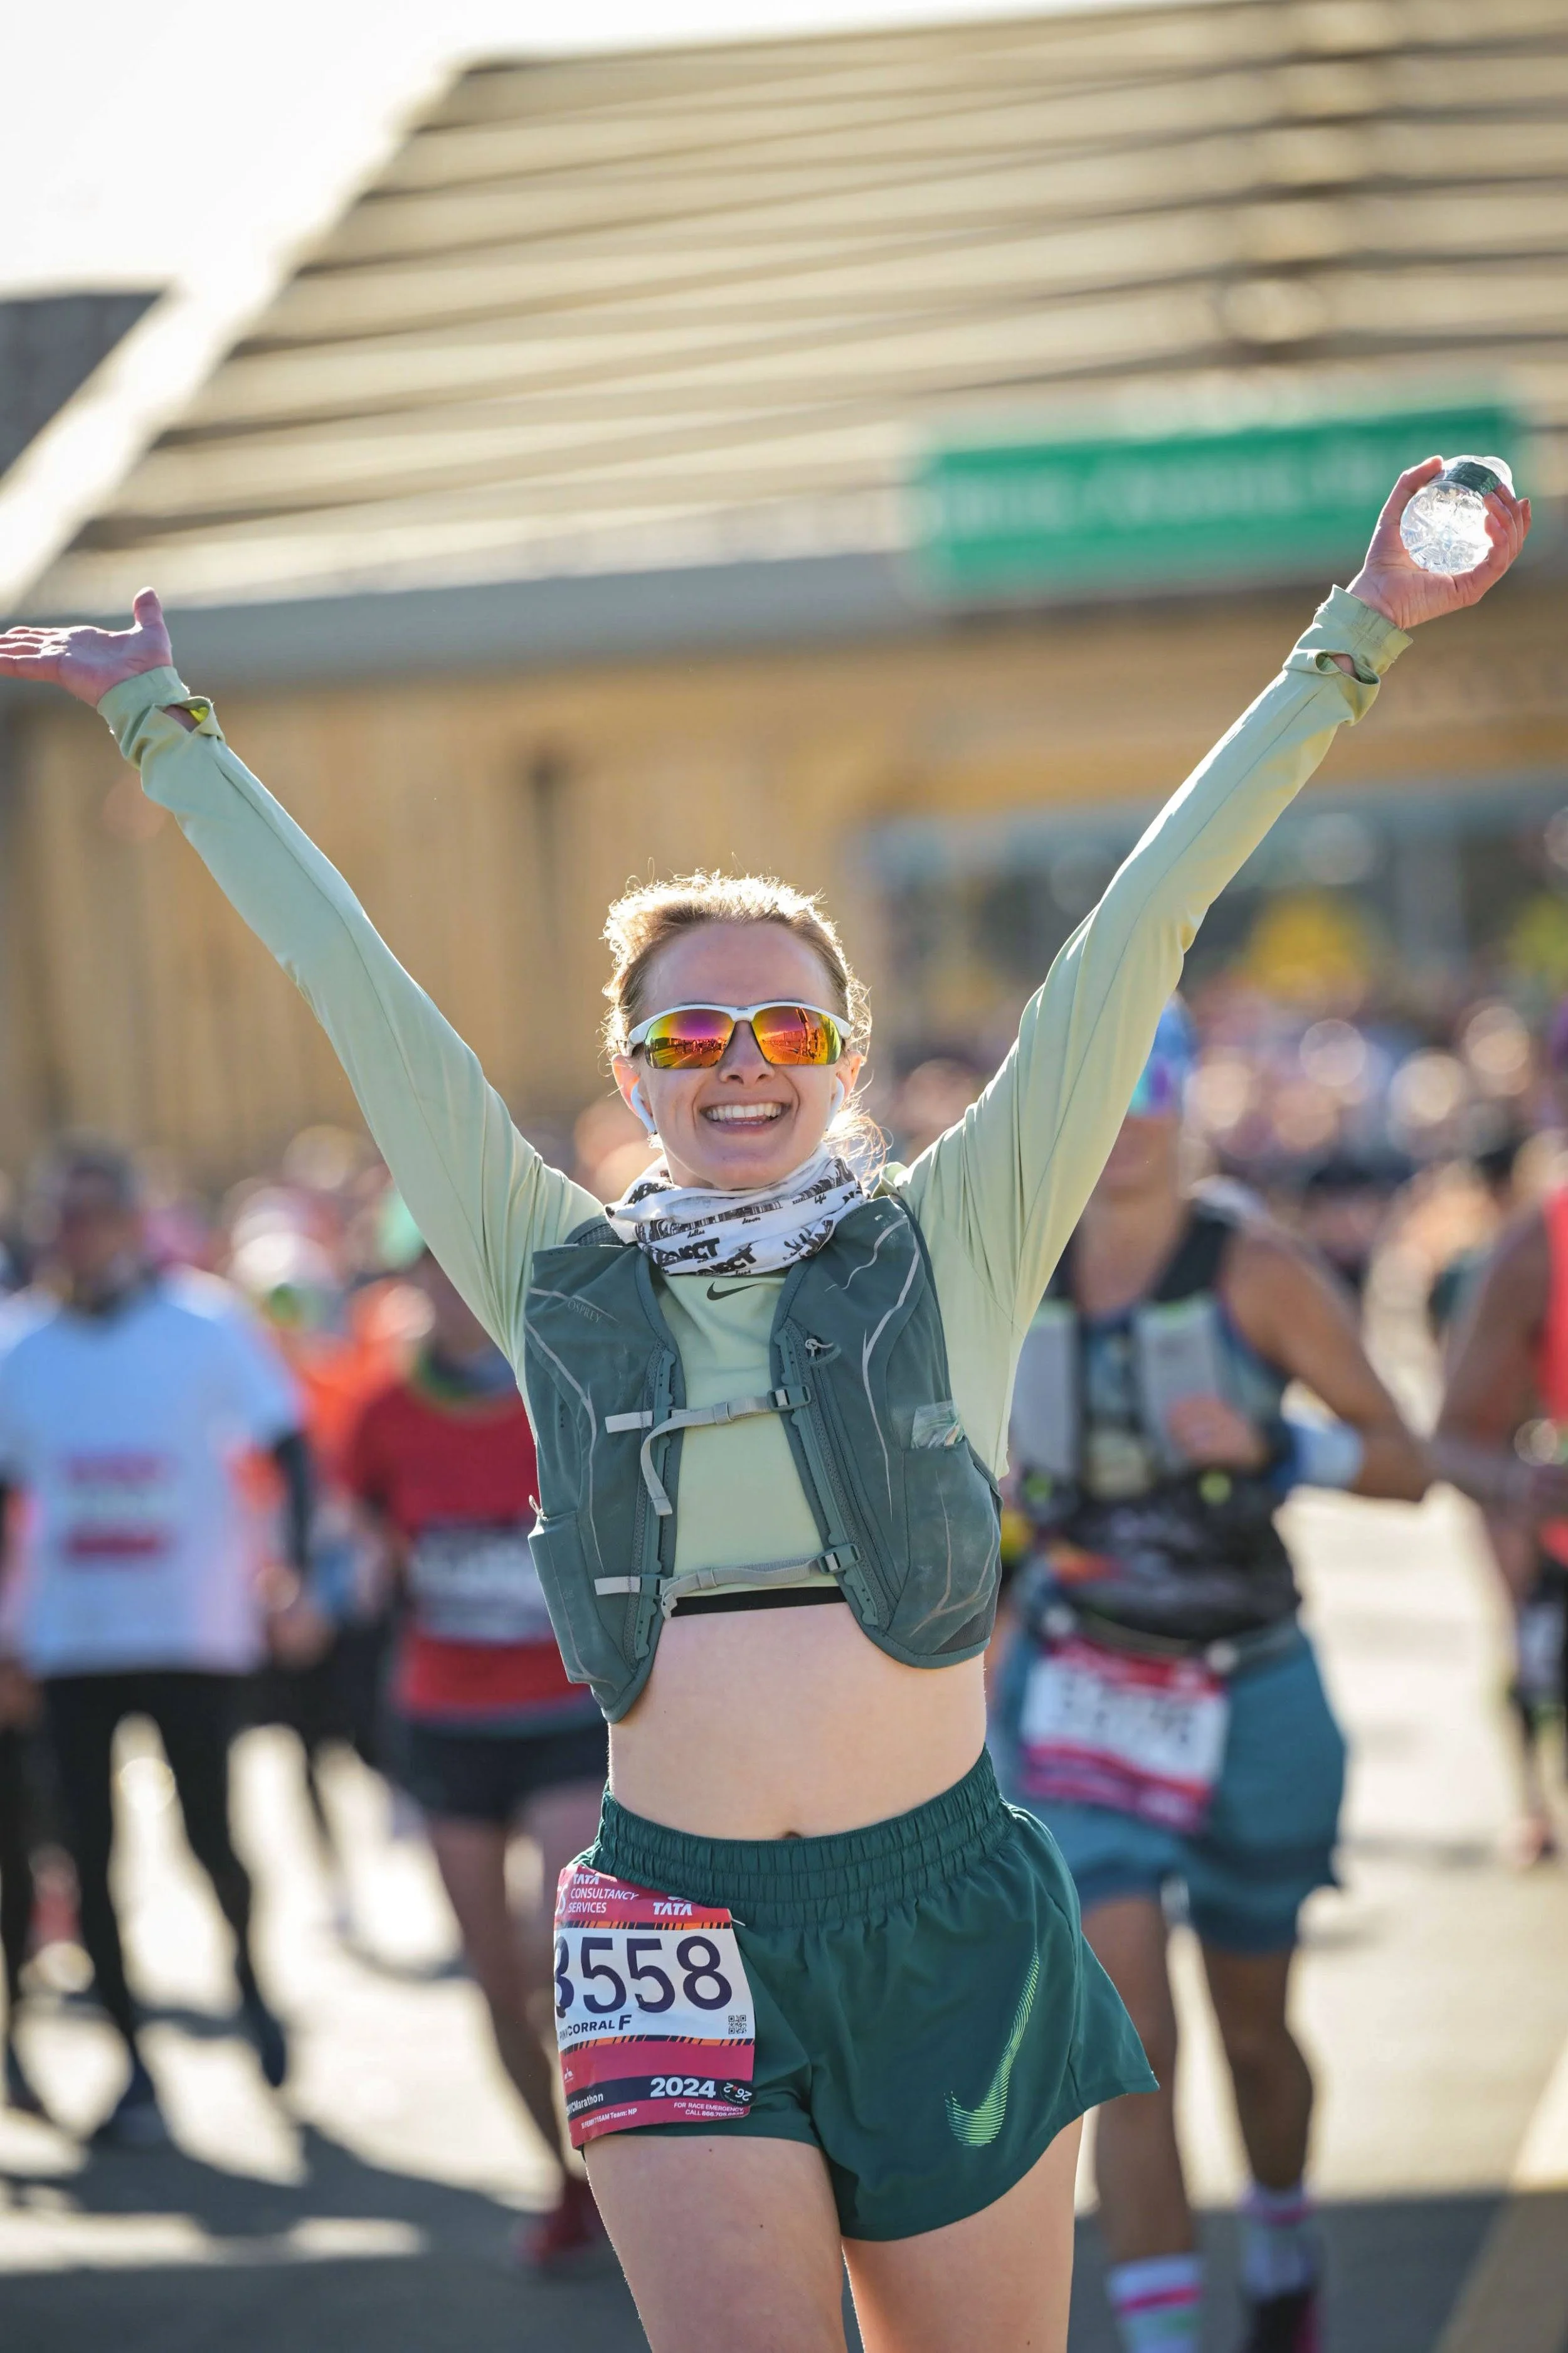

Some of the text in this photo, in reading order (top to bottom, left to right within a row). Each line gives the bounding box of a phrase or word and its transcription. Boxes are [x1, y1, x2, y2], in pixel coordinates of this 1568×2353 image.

[568, 1300, 602, 1322] OSPREY
[573, 1873, 600, 1884] TATA
[570, 1888, 639, 1901] CONSULTANCY
[568, 1902, 607, 1913] SERVICES
[653, 1901, 692, 1916] TATA
[568, 2020, 615, 2036] CORRAL
[618, 2014, 632, 2031] F
[650, 2077, 716, 2098] 2024
[610, 2111, 627, 2119] Team:
